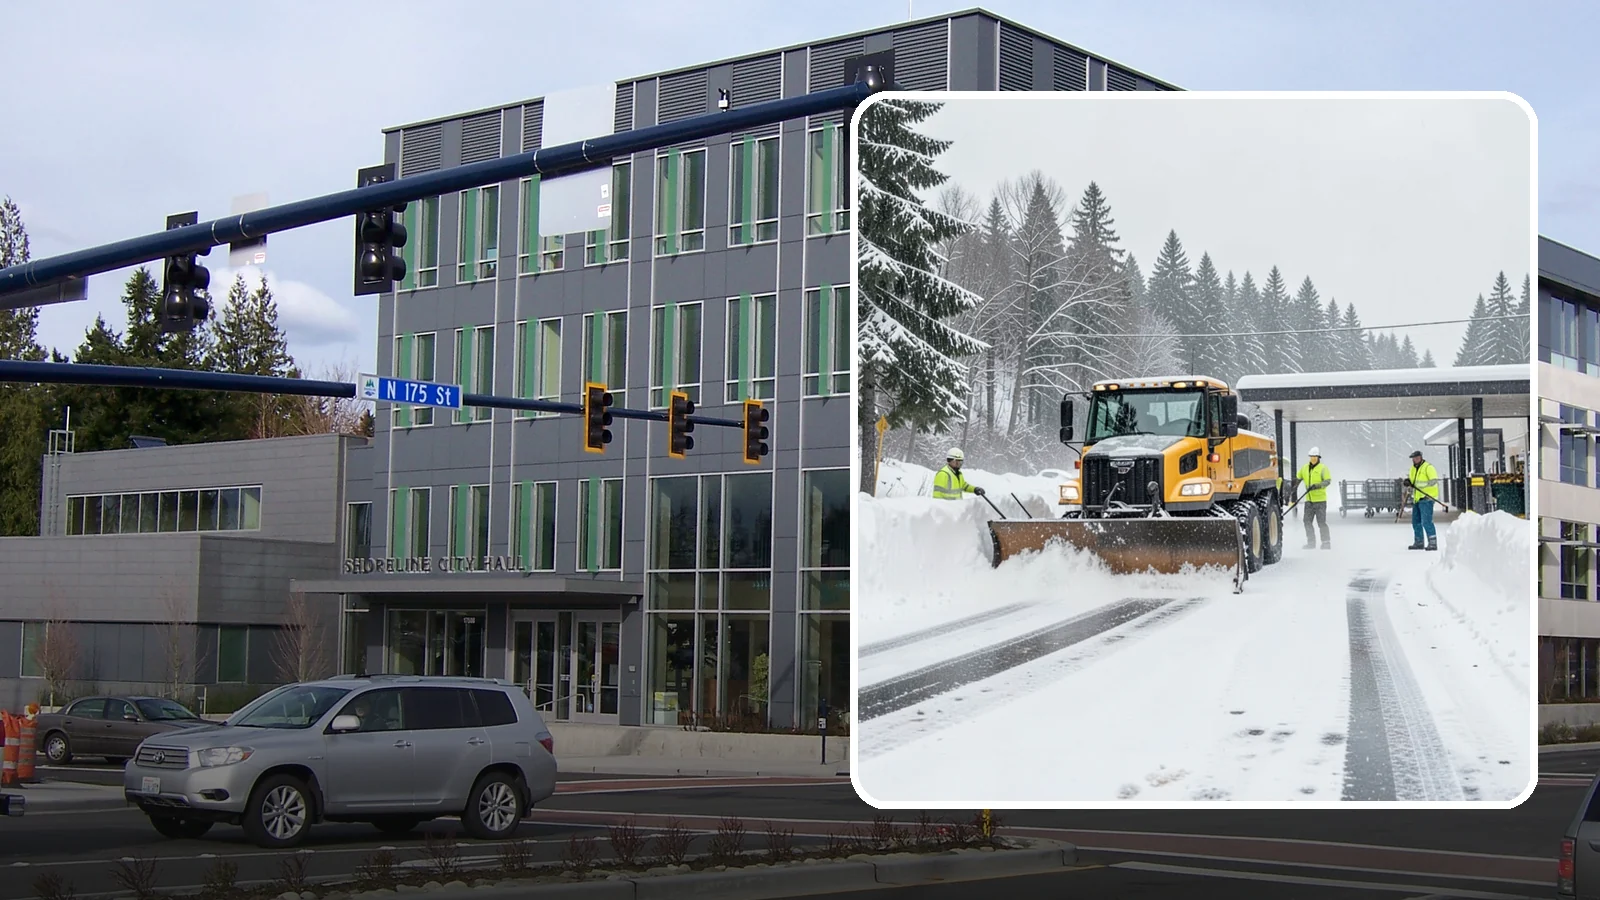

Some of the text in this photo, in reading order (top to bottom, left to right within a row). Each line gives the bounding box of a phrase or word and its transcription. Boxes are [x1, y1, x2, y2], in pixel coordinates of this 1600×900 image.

[387, 380, 451, 406] N 175 St
[344, 556, 525, 574] SHORELINE CITY HALL
